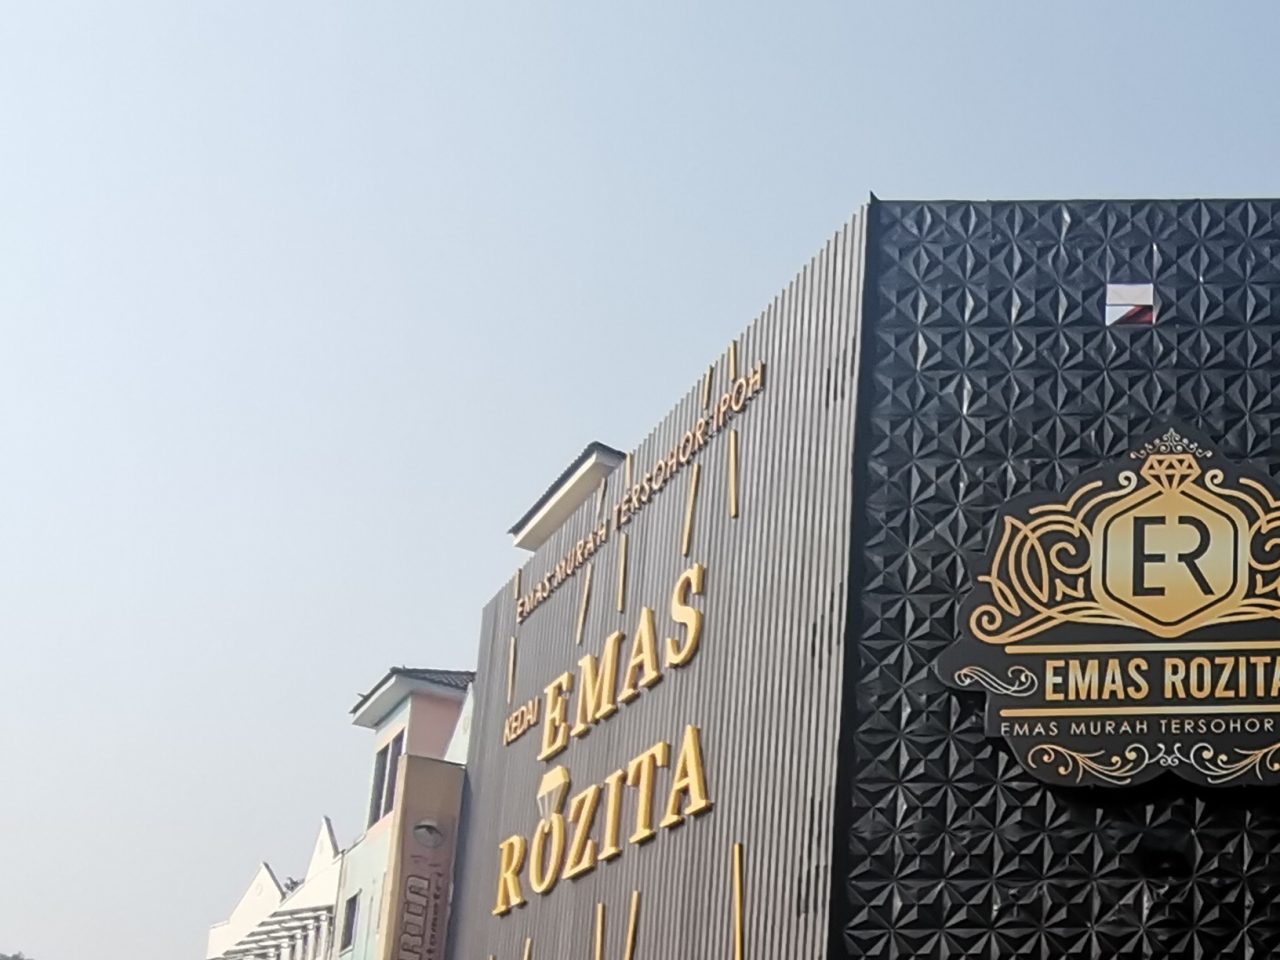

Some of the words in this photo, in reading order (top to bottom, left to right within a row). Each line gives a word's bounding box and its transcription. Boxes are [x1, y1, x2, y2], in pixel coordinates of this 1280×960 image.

[614, 418, 707, 531] TERSOHOR
[712, 361, 766, 430] IPOH
[1132, 515, 1214, 596] ER
[502, 696, 540, 746] KEDAI
[537, 562, 706, 761] EMAS
[1045, 658, 1150, 700] EMAS
[1001, 720, 1058, 736] EMAS
[1070, 719, 1148, 735] MURAH
[1160, 717, 1275, 734] TERSOHOR
[492, 724, 713, 916] ROZITA
